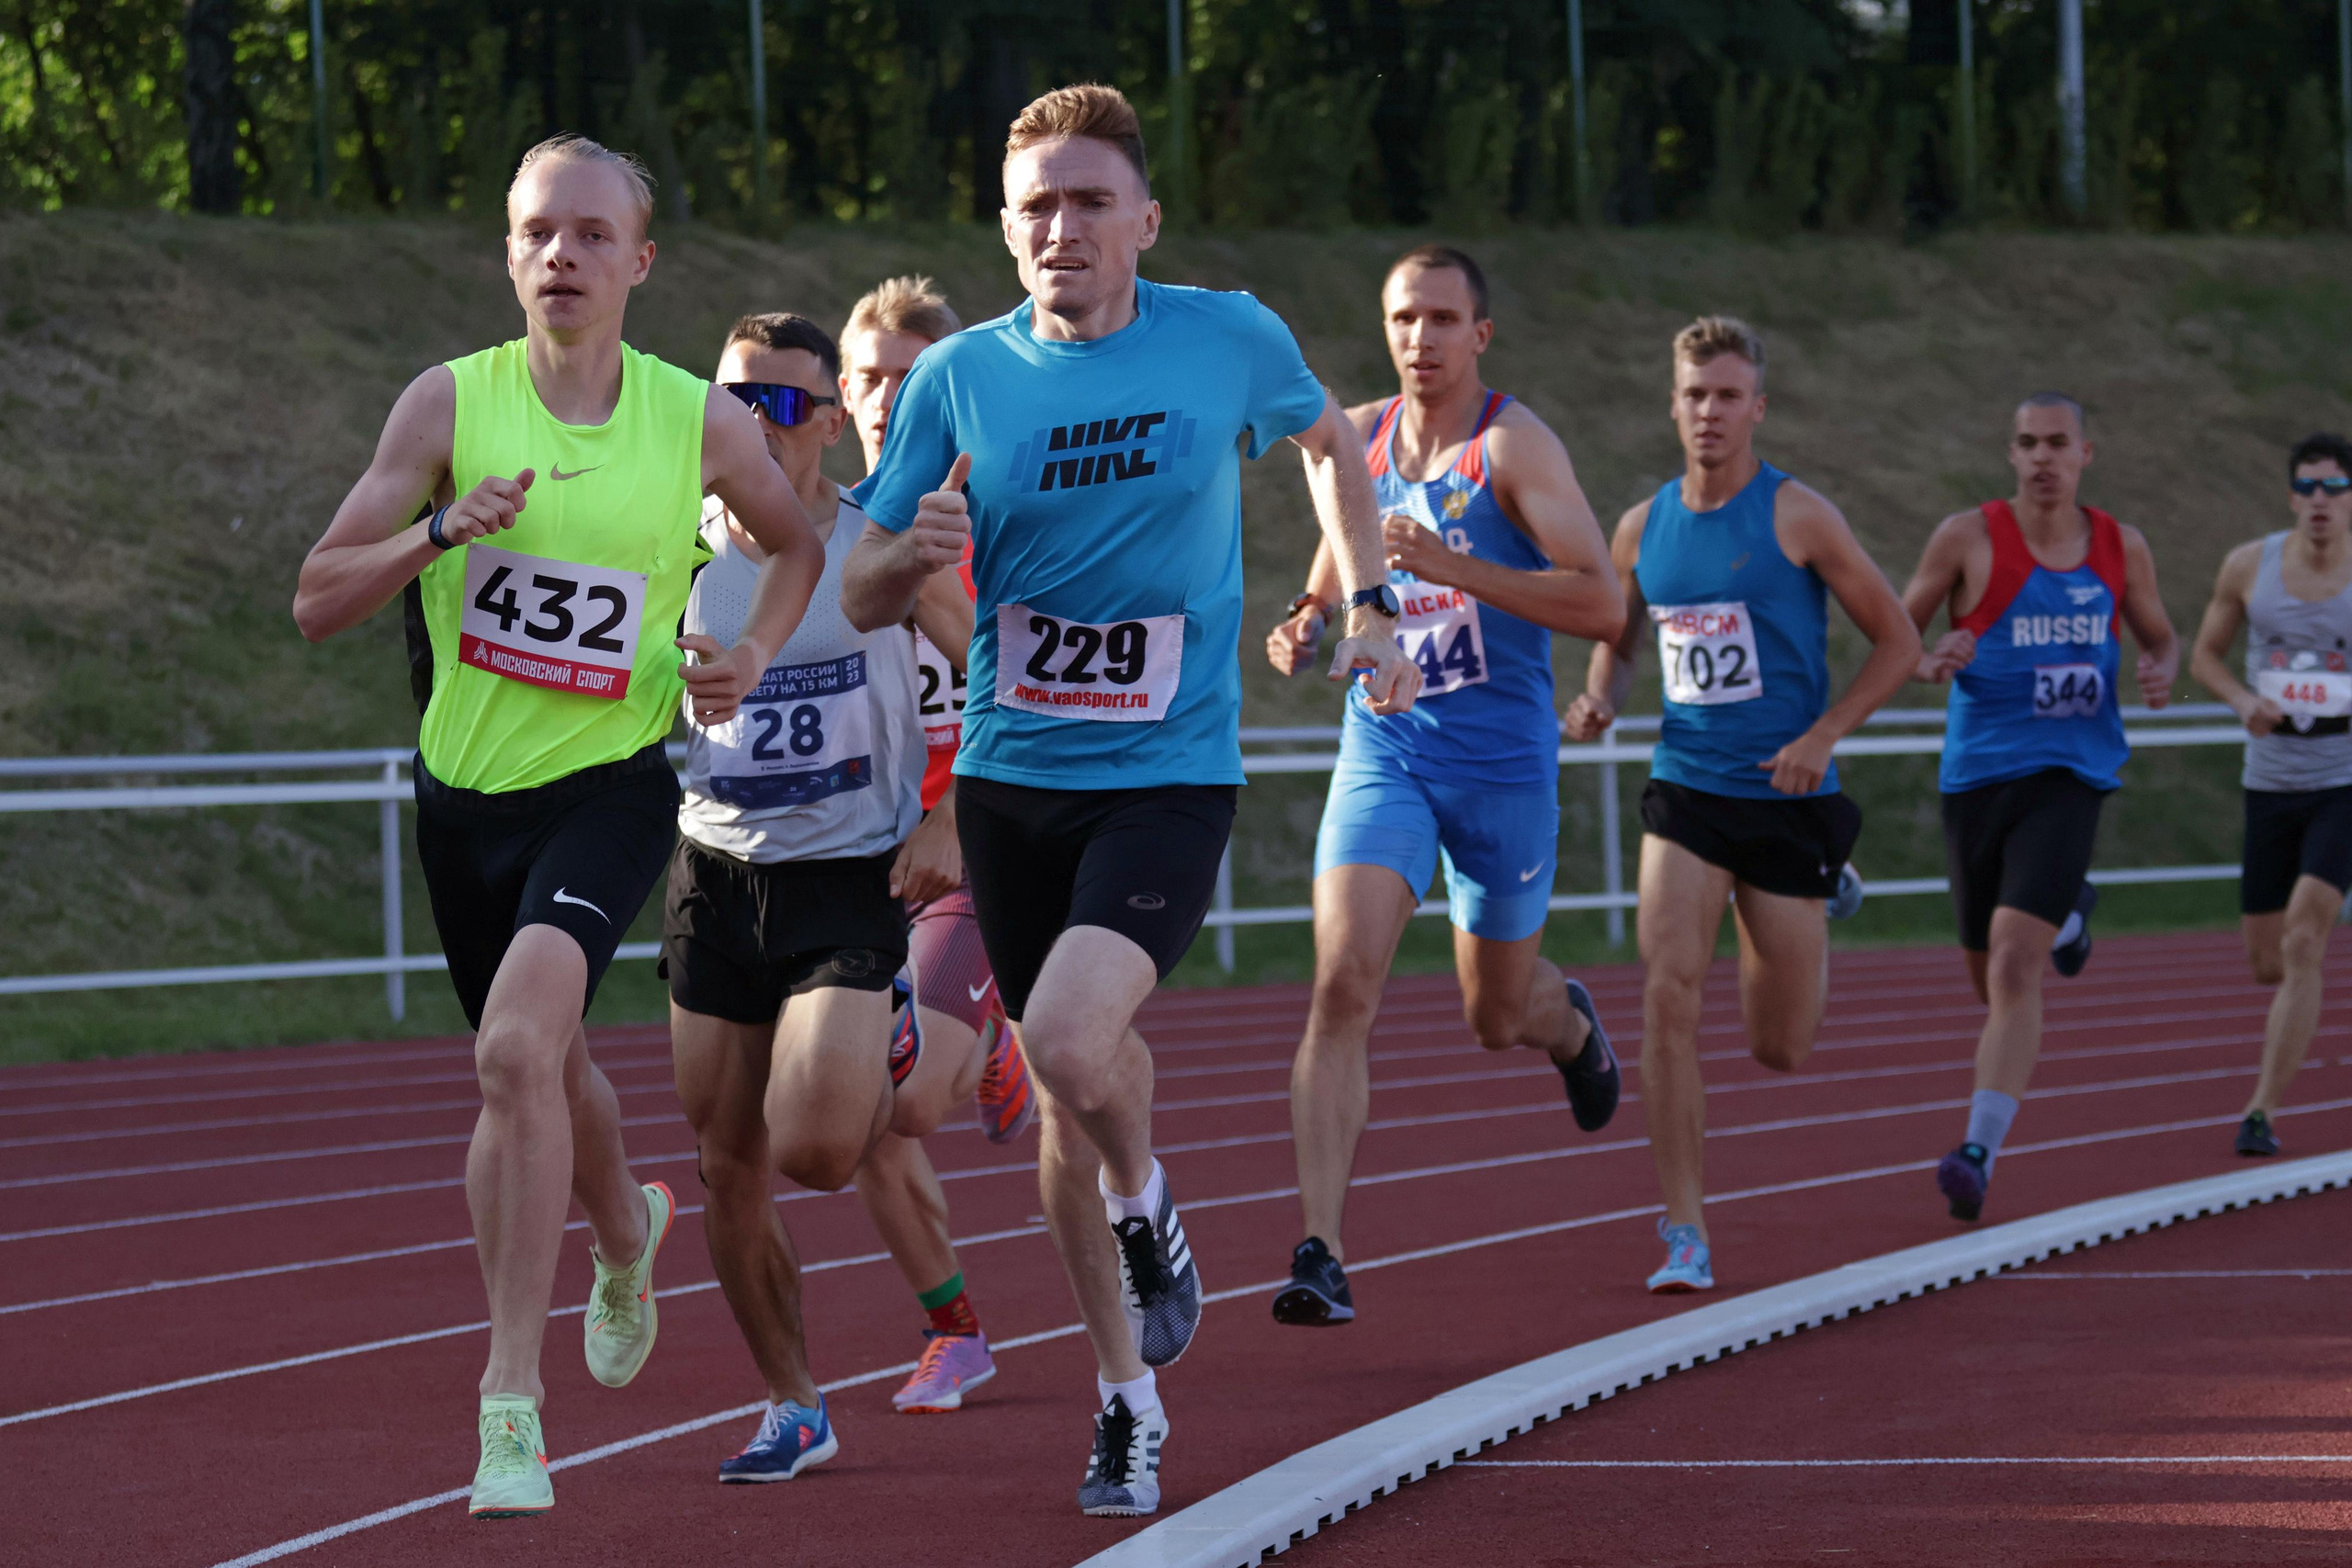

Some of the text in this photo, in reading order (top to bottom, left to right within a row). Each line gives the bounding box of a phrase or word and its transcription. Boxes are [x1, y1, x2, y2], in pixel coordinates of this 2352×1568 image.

[1038, 412, 1167, 491] NIKE
[474, 566, 627, 654] 432
[1405, 590, 1466, 616] ЦСКА
[845, 657, 859, 671] 20
[1025, 615, 1148, 684] 229
[491, 649, 616, 691] МОСКОВСКИЙ СПОРТ
[787, 663, 837, 681] РОССИИ
[846, 670, 860, 684] 23
[1667, 642, 1751, 692] 702
[780, 682, 797, 694] НА
[801, 681, 815, 692] 15
[819, 677, 838, 689] КМ
[1014, 682, 1148, 708] www.vaosport.ru
[2037, 671, 2098, 709] 344
[2282, 683, 2327, 705] 448
[752, 704, 824, 761] 28
